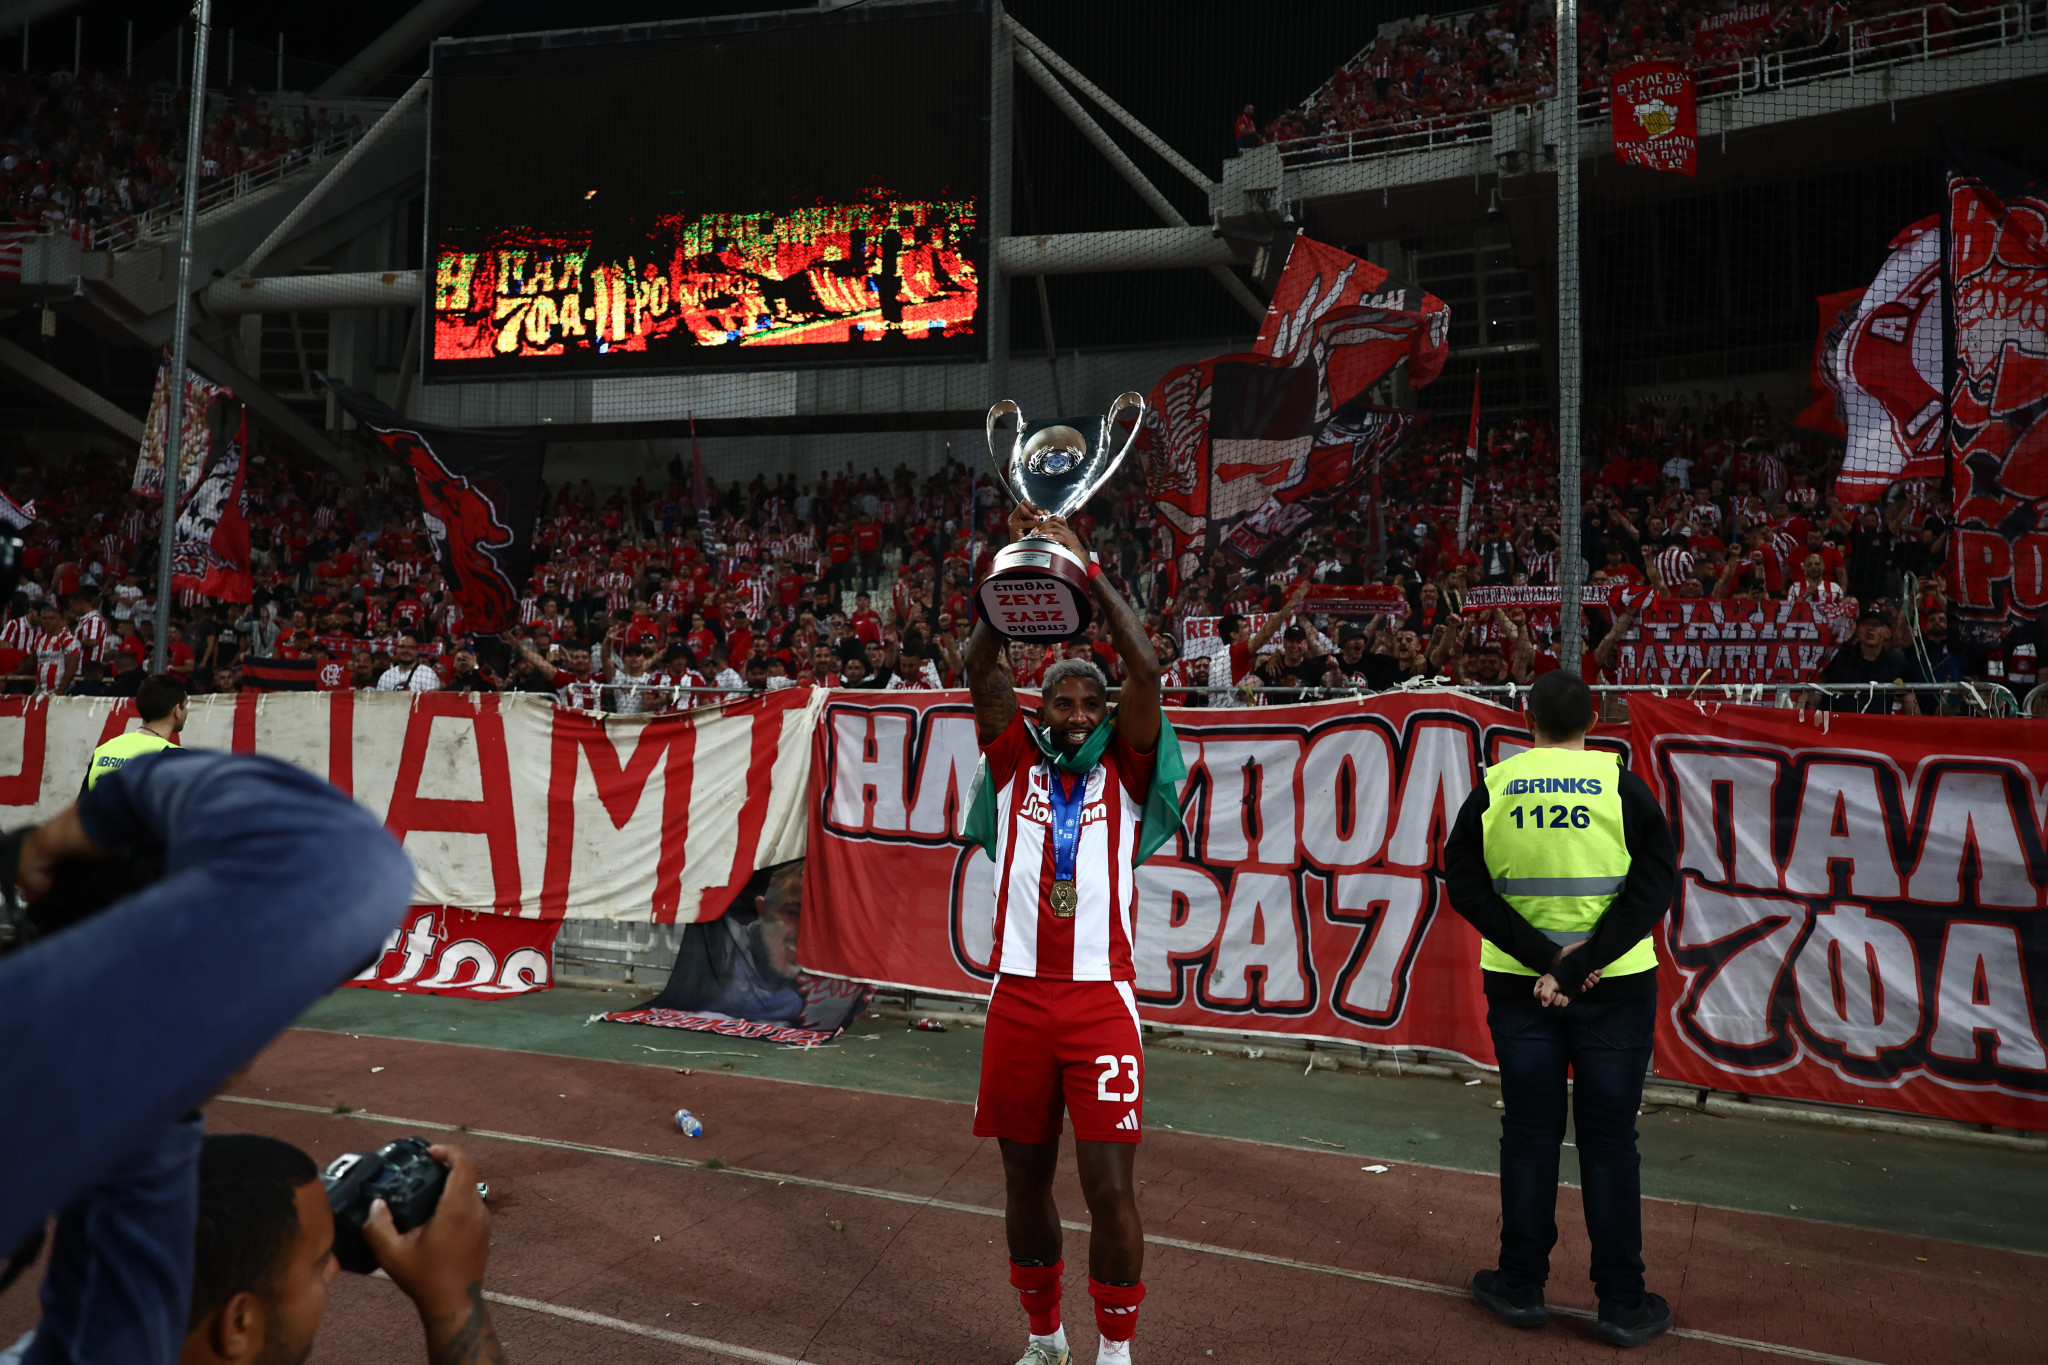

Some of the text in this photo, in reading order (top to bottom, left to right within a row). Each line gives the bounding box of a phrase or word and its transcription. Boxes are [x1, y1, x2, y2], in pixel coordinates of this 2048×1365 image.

[993, 582, 1055, 591] έπαθλα
[996, 593, 1060, 606] ΖΕΥΣ
[1002, 611, 1065, 623] ΖΕΥΣ
[1007, 624, 1068, 633] έπαθλα
[1513, 778, 1602, 795] BRINKS
[1510, 805, 1590, 829] 1126
[1658, 742, 2048, 908] ΠΑΛ
[1326, 870, 1432, 1020] 7
[1094, 1054, 1140, 1103] 23
